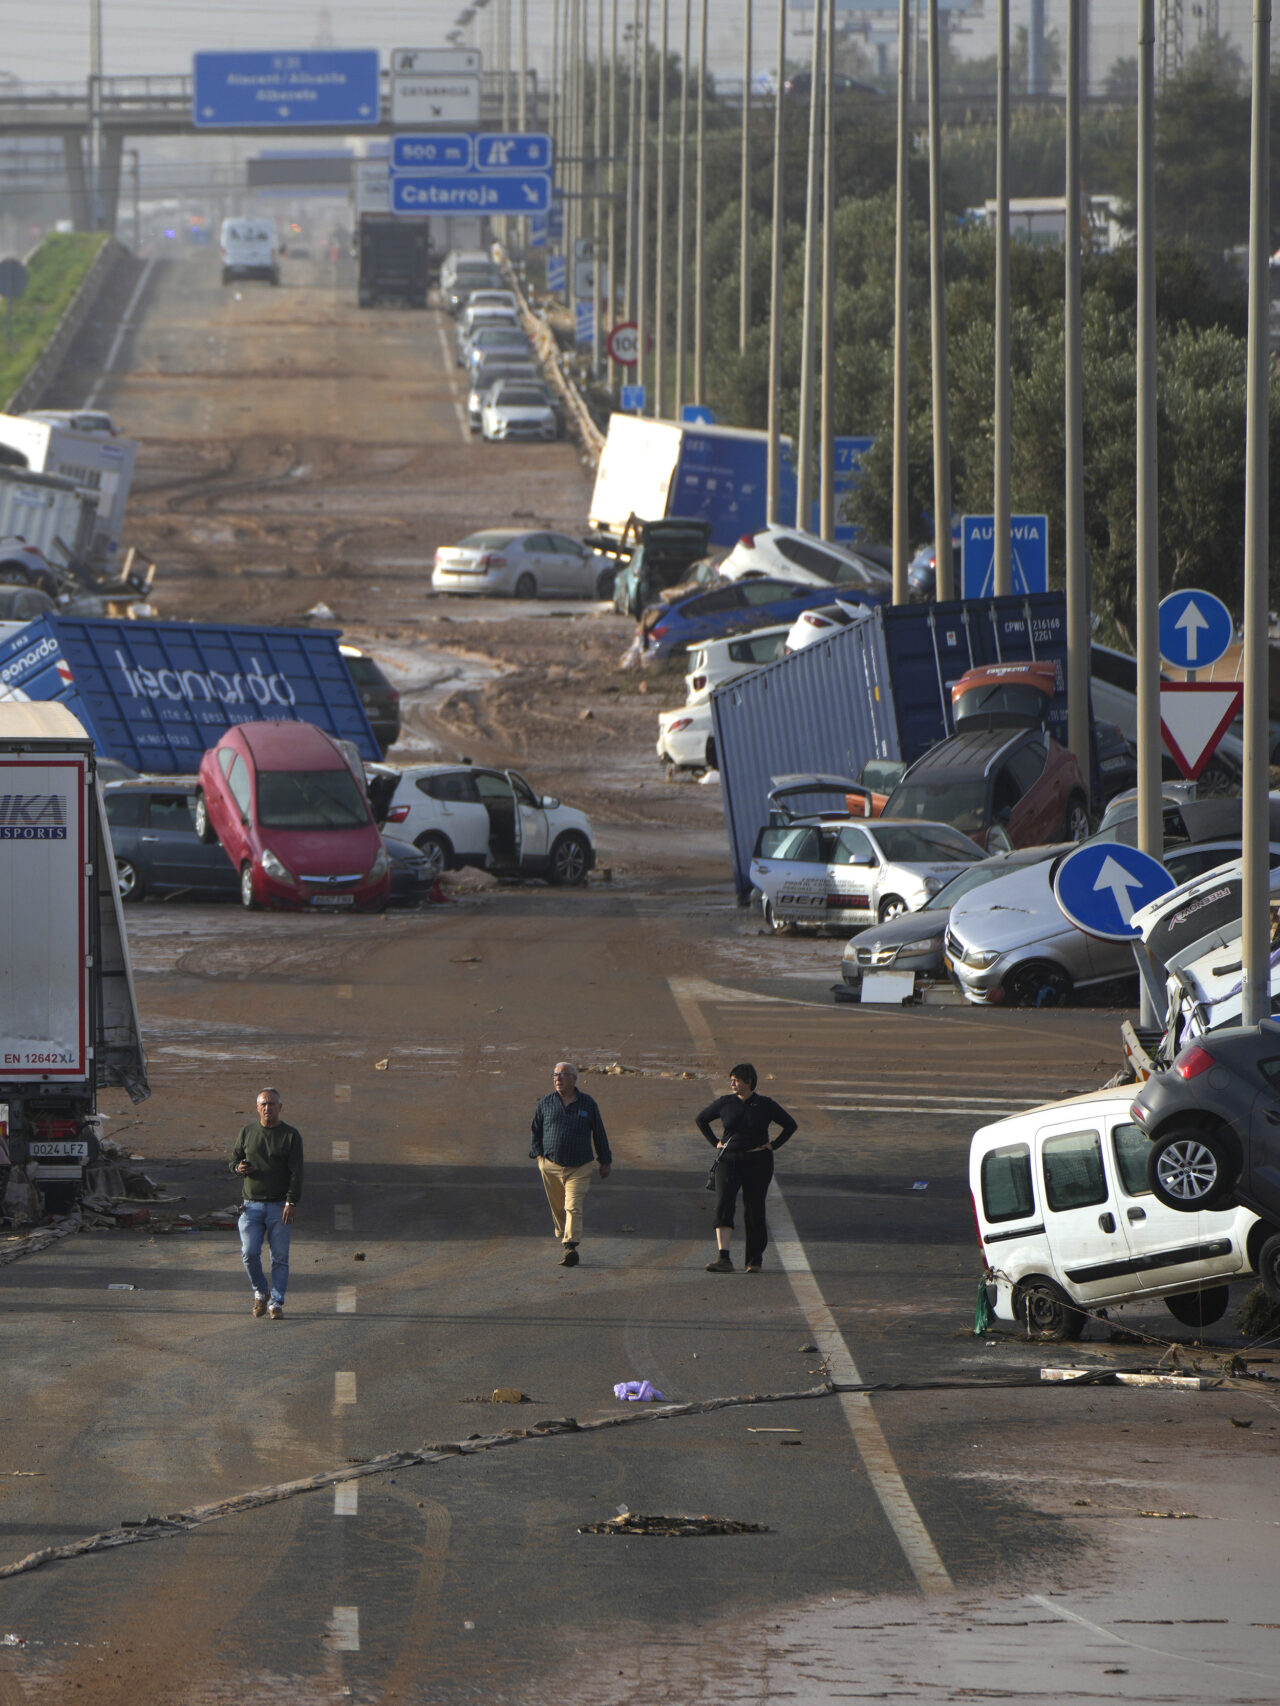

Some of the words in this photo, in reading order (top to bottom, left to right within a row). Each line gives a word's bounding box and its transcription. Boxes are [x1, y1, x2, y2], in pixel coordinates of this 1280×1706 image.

[444, 147, 462, 160] m
[401, 184, 500, 207] Catarroja
[114, 649, 297, 707] leonardo
[4, 1053, 21, 1064] EN
[33, 1143, 60, 1156] 0024
[62, 1144, 85, 1155] LFZ
